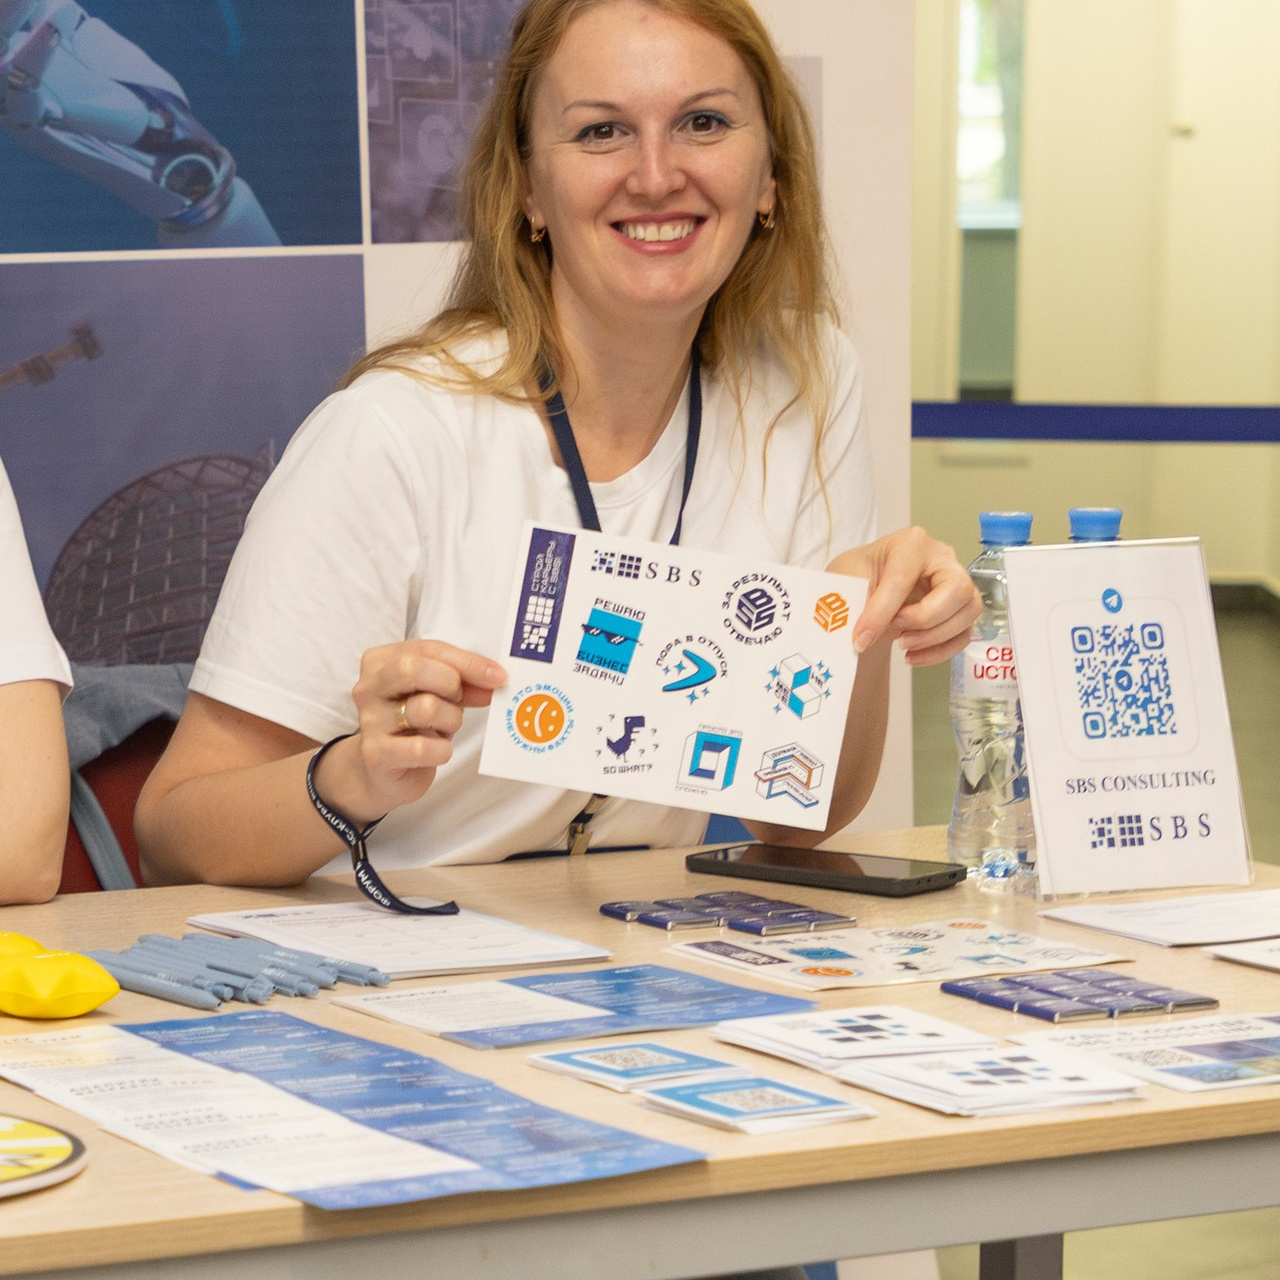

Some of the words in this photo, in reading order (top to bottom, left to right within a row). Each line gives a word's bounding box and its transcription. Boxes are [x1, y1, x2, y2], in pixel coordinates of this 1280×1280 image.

[645, 561, 703, 587] SBS
[1065, 777, 1097, 795] SBS
[1101, 770, 1217, 793] CONSULTING
[1149, 812, 1212, 841] SBS
